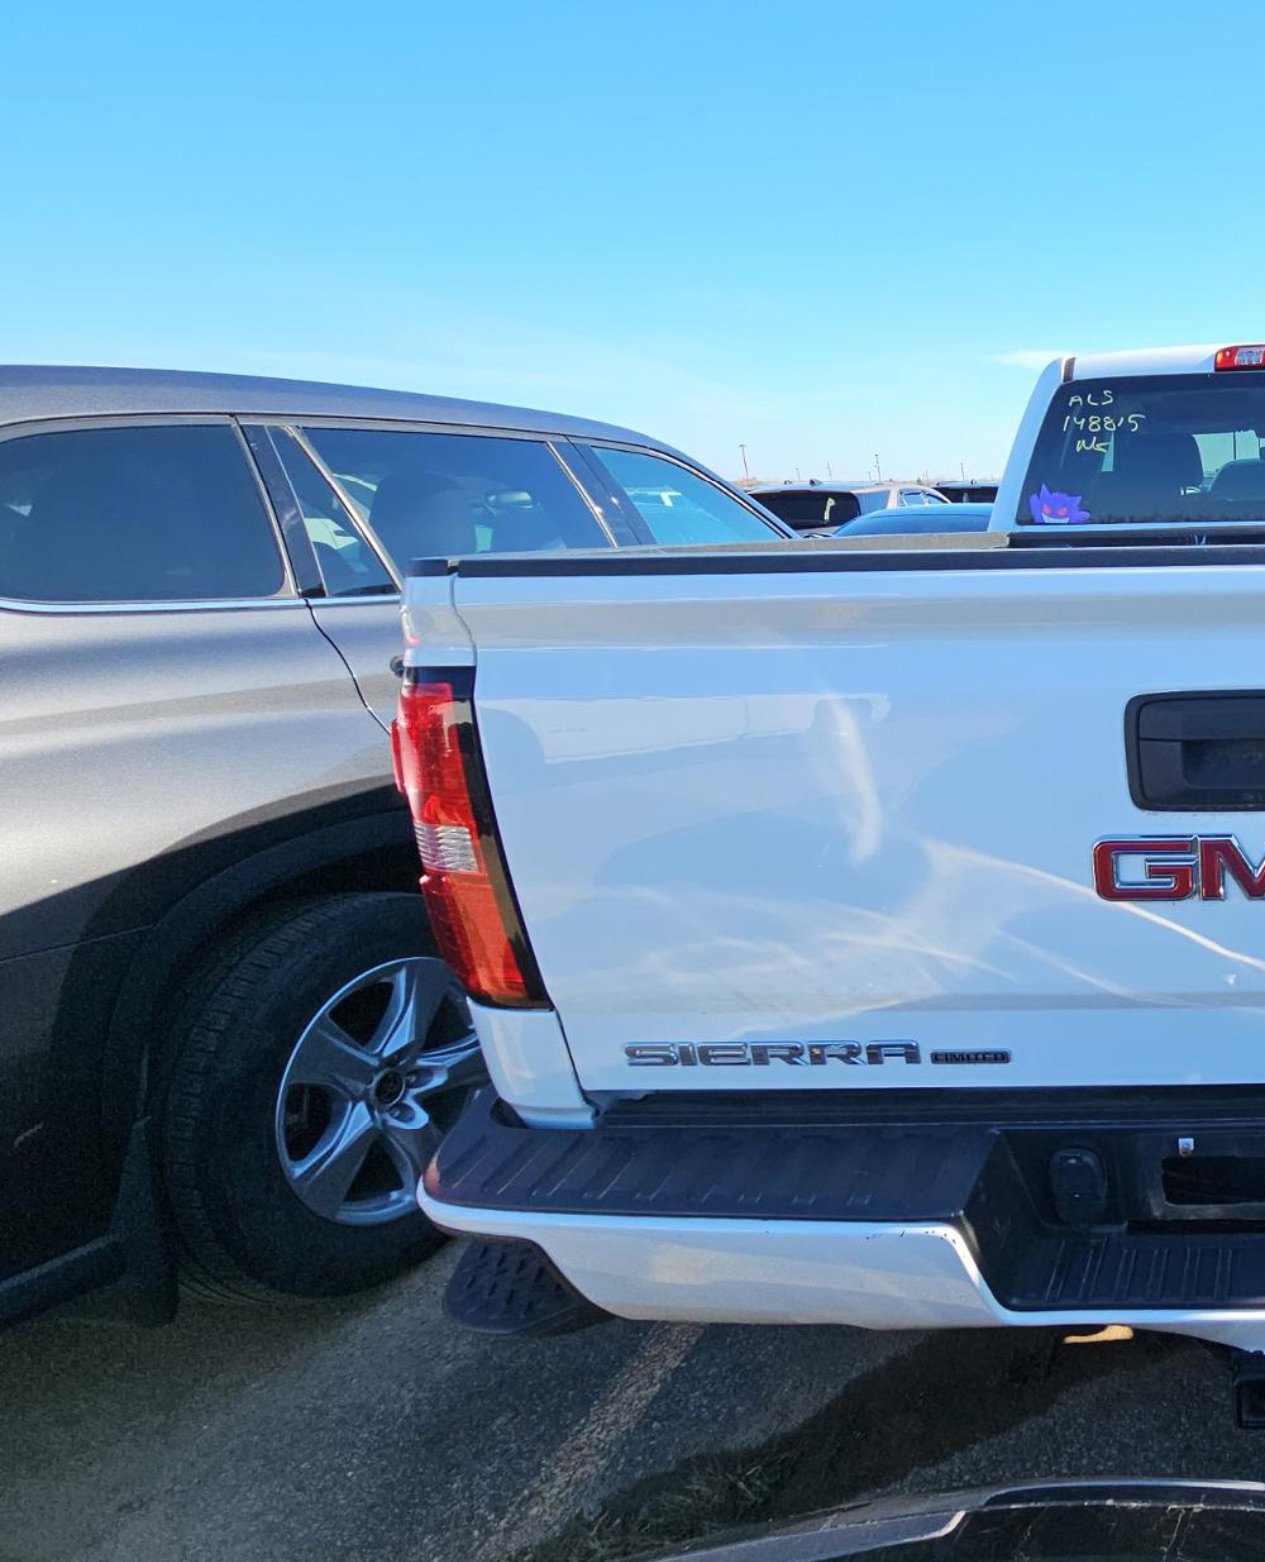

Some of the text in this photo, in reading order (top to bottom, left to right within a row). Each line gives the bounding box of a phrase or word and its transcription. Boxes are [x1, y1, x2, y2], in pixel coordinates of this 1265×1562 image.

[1068, 389, 1114, 407] ALS
[1063, 413, 1146, 433] 148815
[624, 1041, 922, 1067] SIERRA
